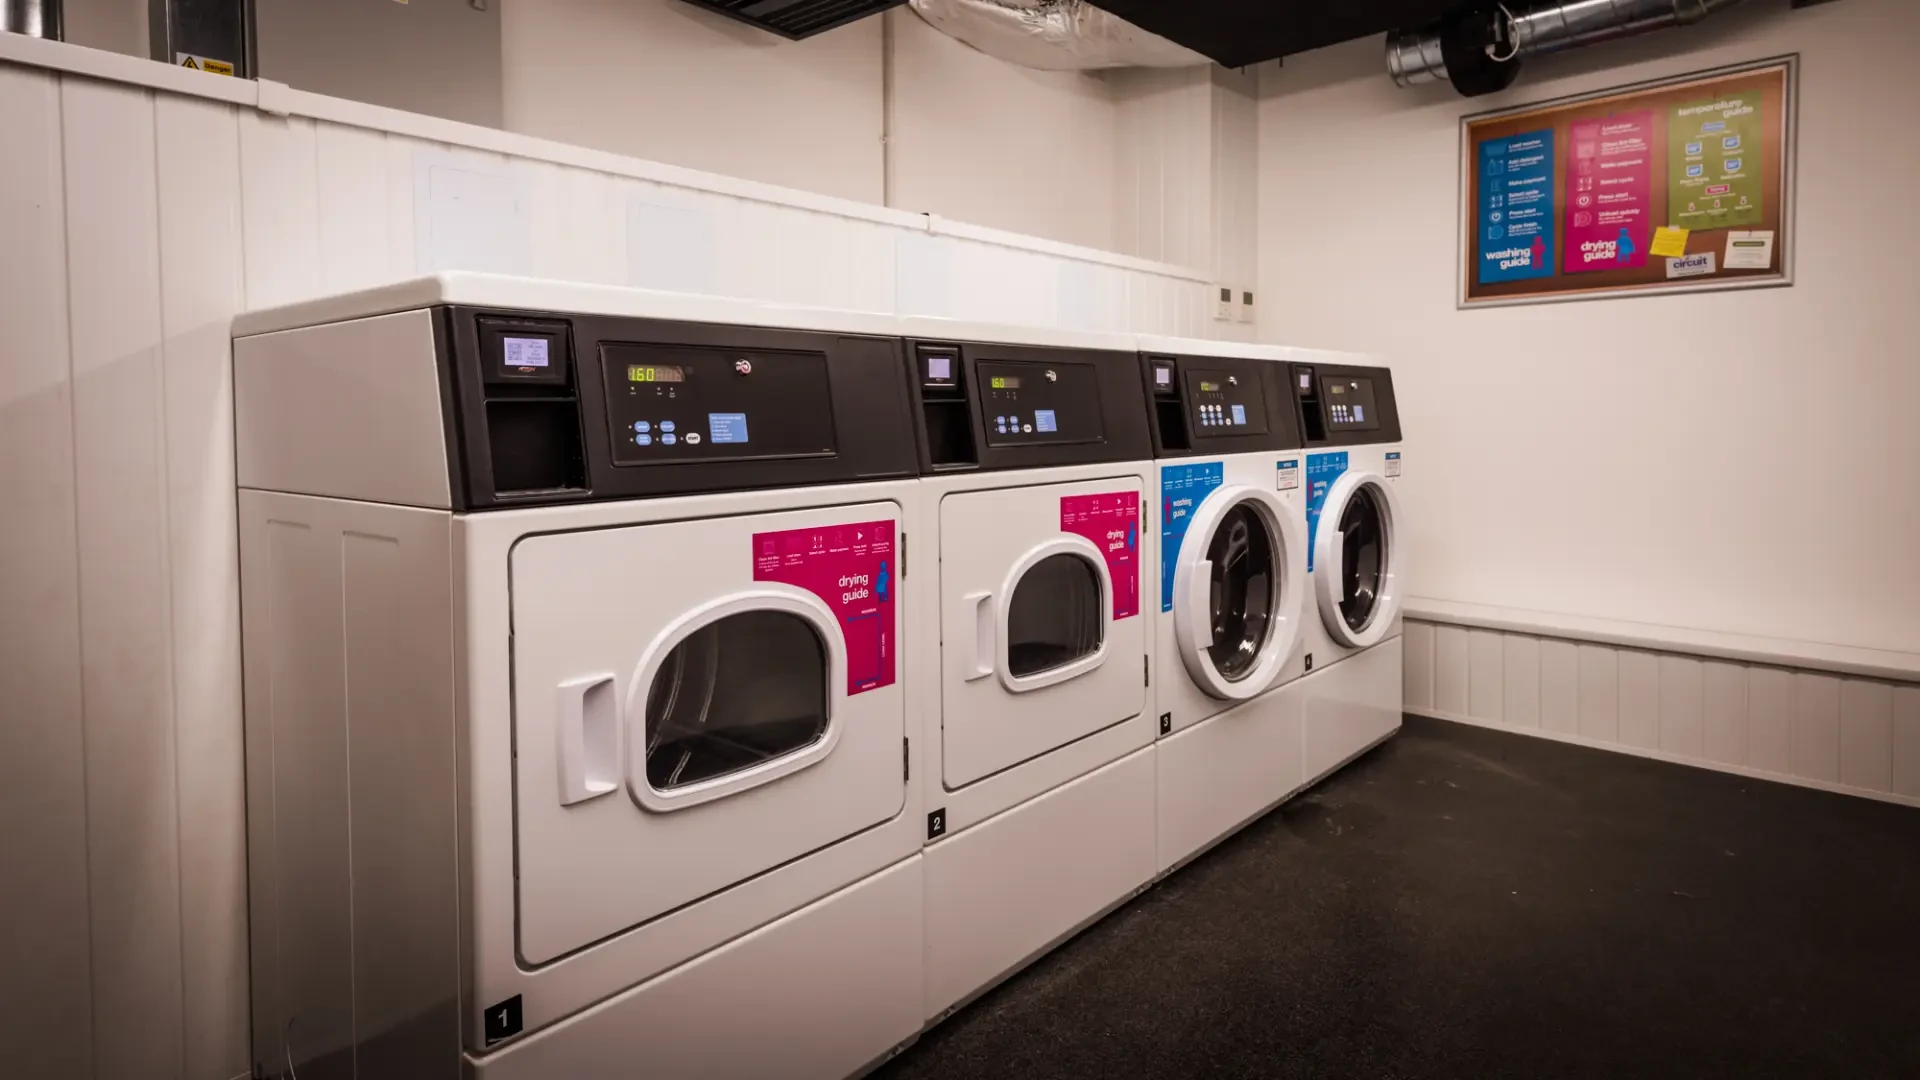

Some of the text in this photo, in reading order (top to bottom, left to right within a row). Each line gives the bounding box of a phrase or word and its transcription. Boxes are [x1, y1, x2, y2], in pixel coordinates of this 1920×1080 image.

[204, 62, 231, 73] Danger
[1678, 99, 1743, 117] temperature
[1723, 106, 1754, 119] guide
[1580, 239, 1617, 253] drying
[1485, 247, 1531, 261] washing
[1584, 250, 1616, 263] guide
[1500, 256, 1531, 270] guide
[1673, 256, 1708, 269] circuit
[1173, 497, 1192, 508] washing
[1173, 508, 1186, 520] guide
[1107, 529, 1124, 540] drying
[1109, 540, 1124, 552] guide
[838, 574, 869, 588] drying
[842, 588, 869, 604] guide
[1163, 716, 1169, 727] 3
[933, 816, 941, 831] 2
[498, 1008, 508, 1028] 1
